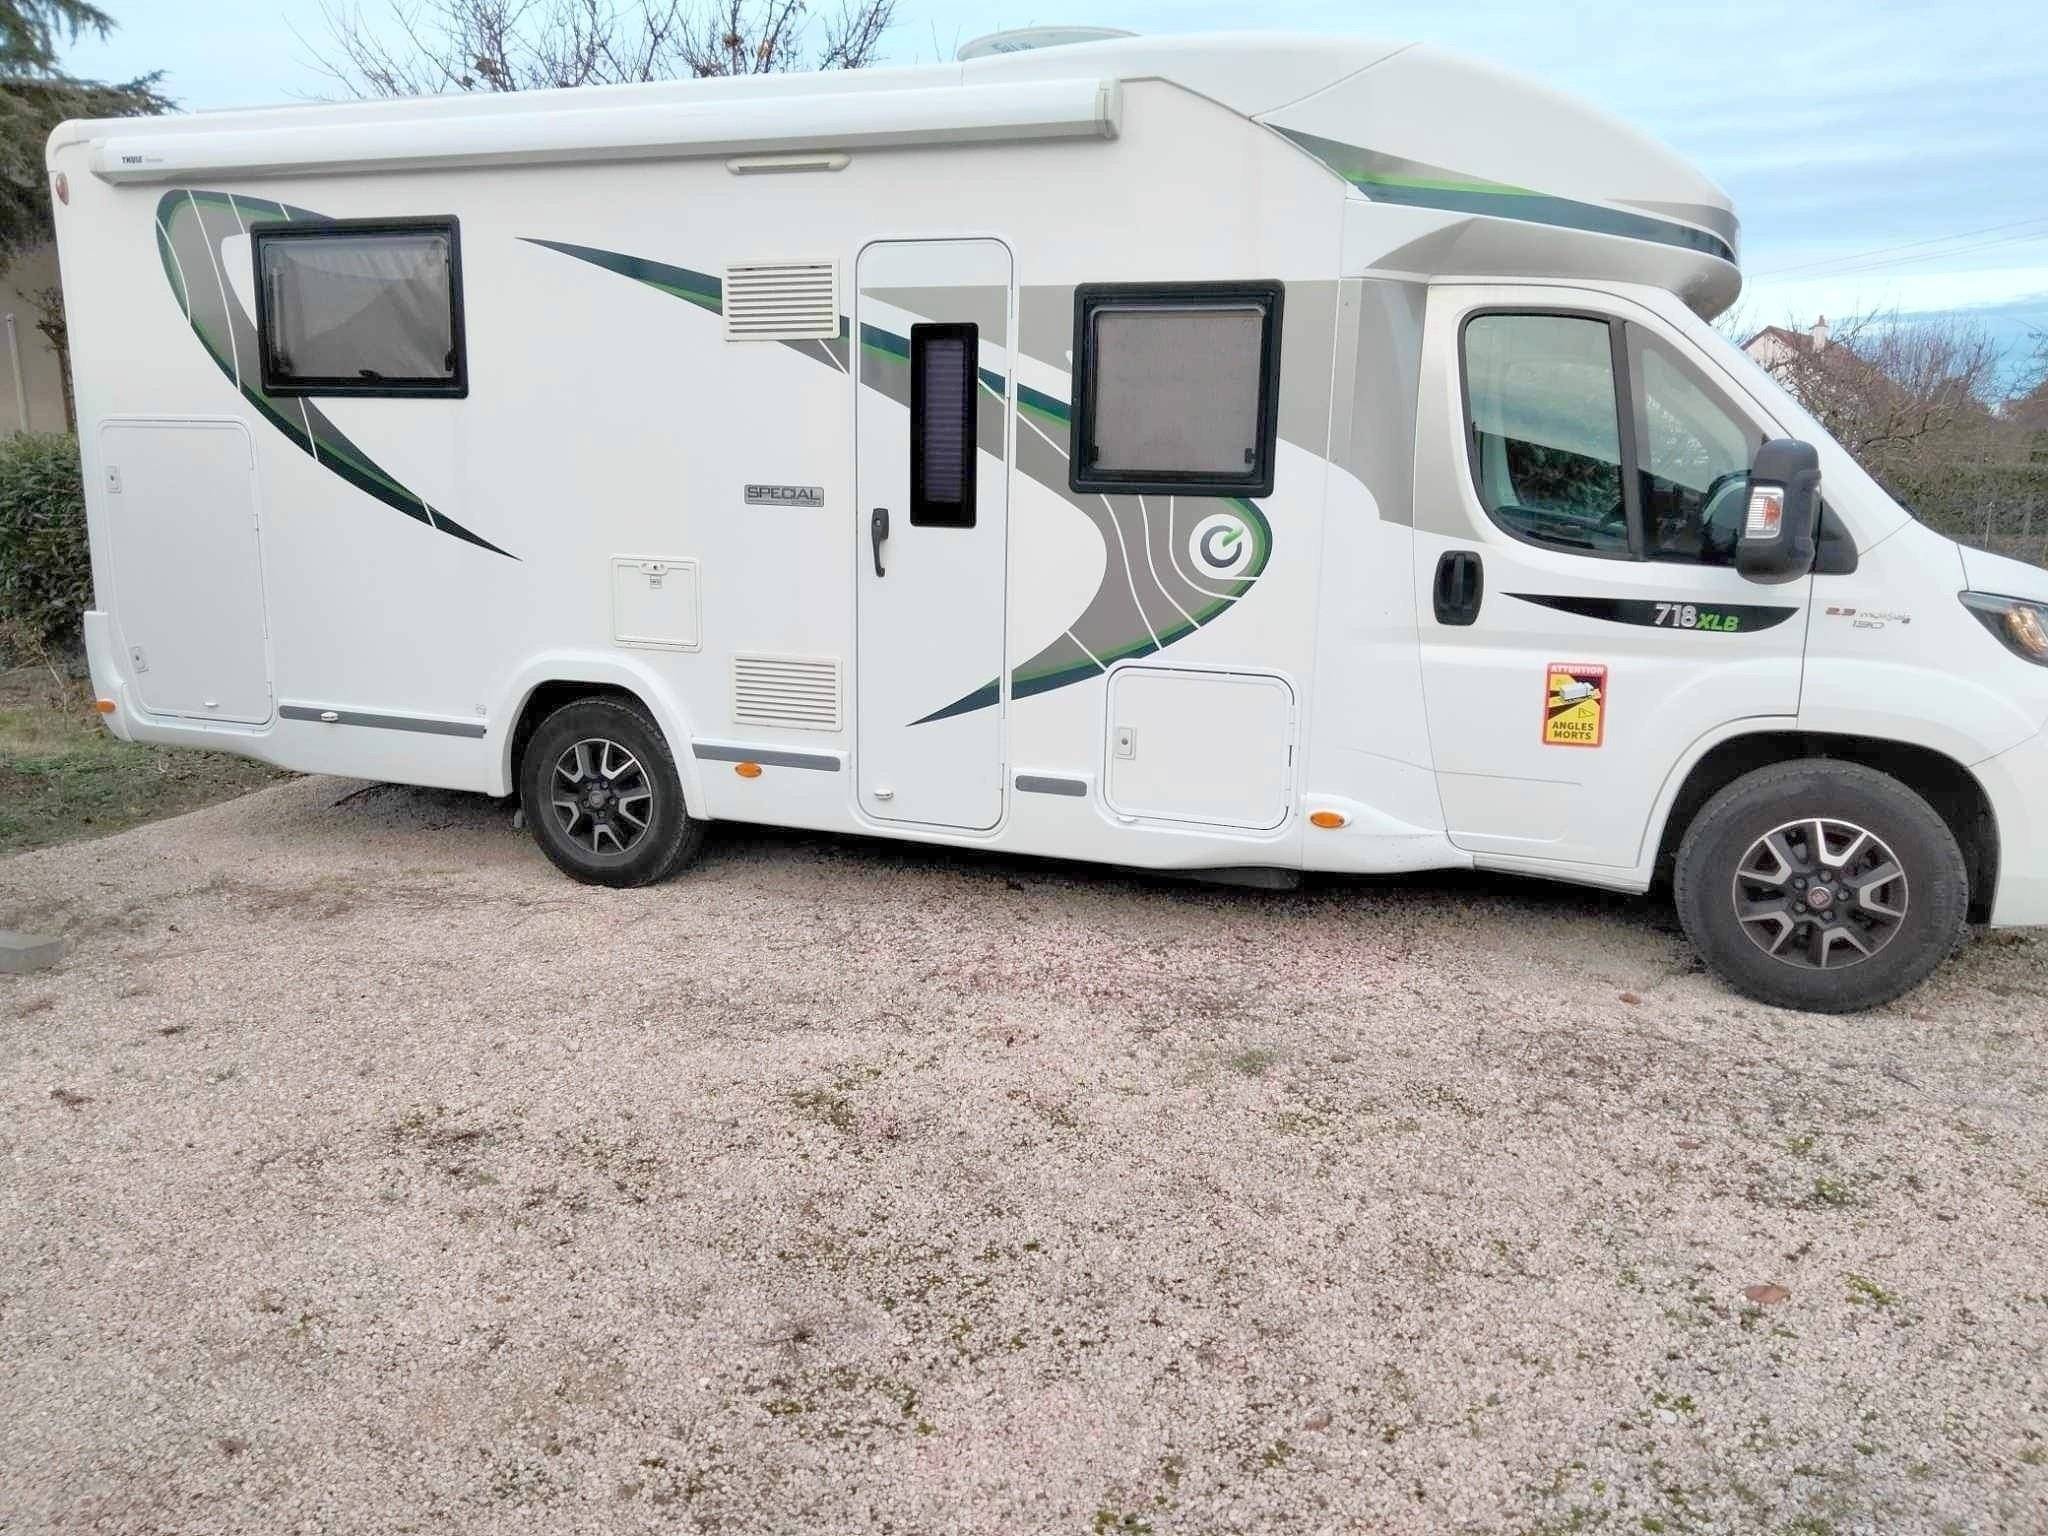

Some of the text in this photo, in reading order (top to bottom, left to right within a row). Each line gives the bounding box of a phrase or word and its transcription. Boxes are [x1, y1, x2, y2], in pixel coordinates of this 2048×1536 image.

[747, 487, 821, 500] SPECIAL
[1551, 665, 1604, 675] ATTENTION
[1552, 721, 1594, 731] ANGLES
[1554, 730, 1592, 740] MORTS
